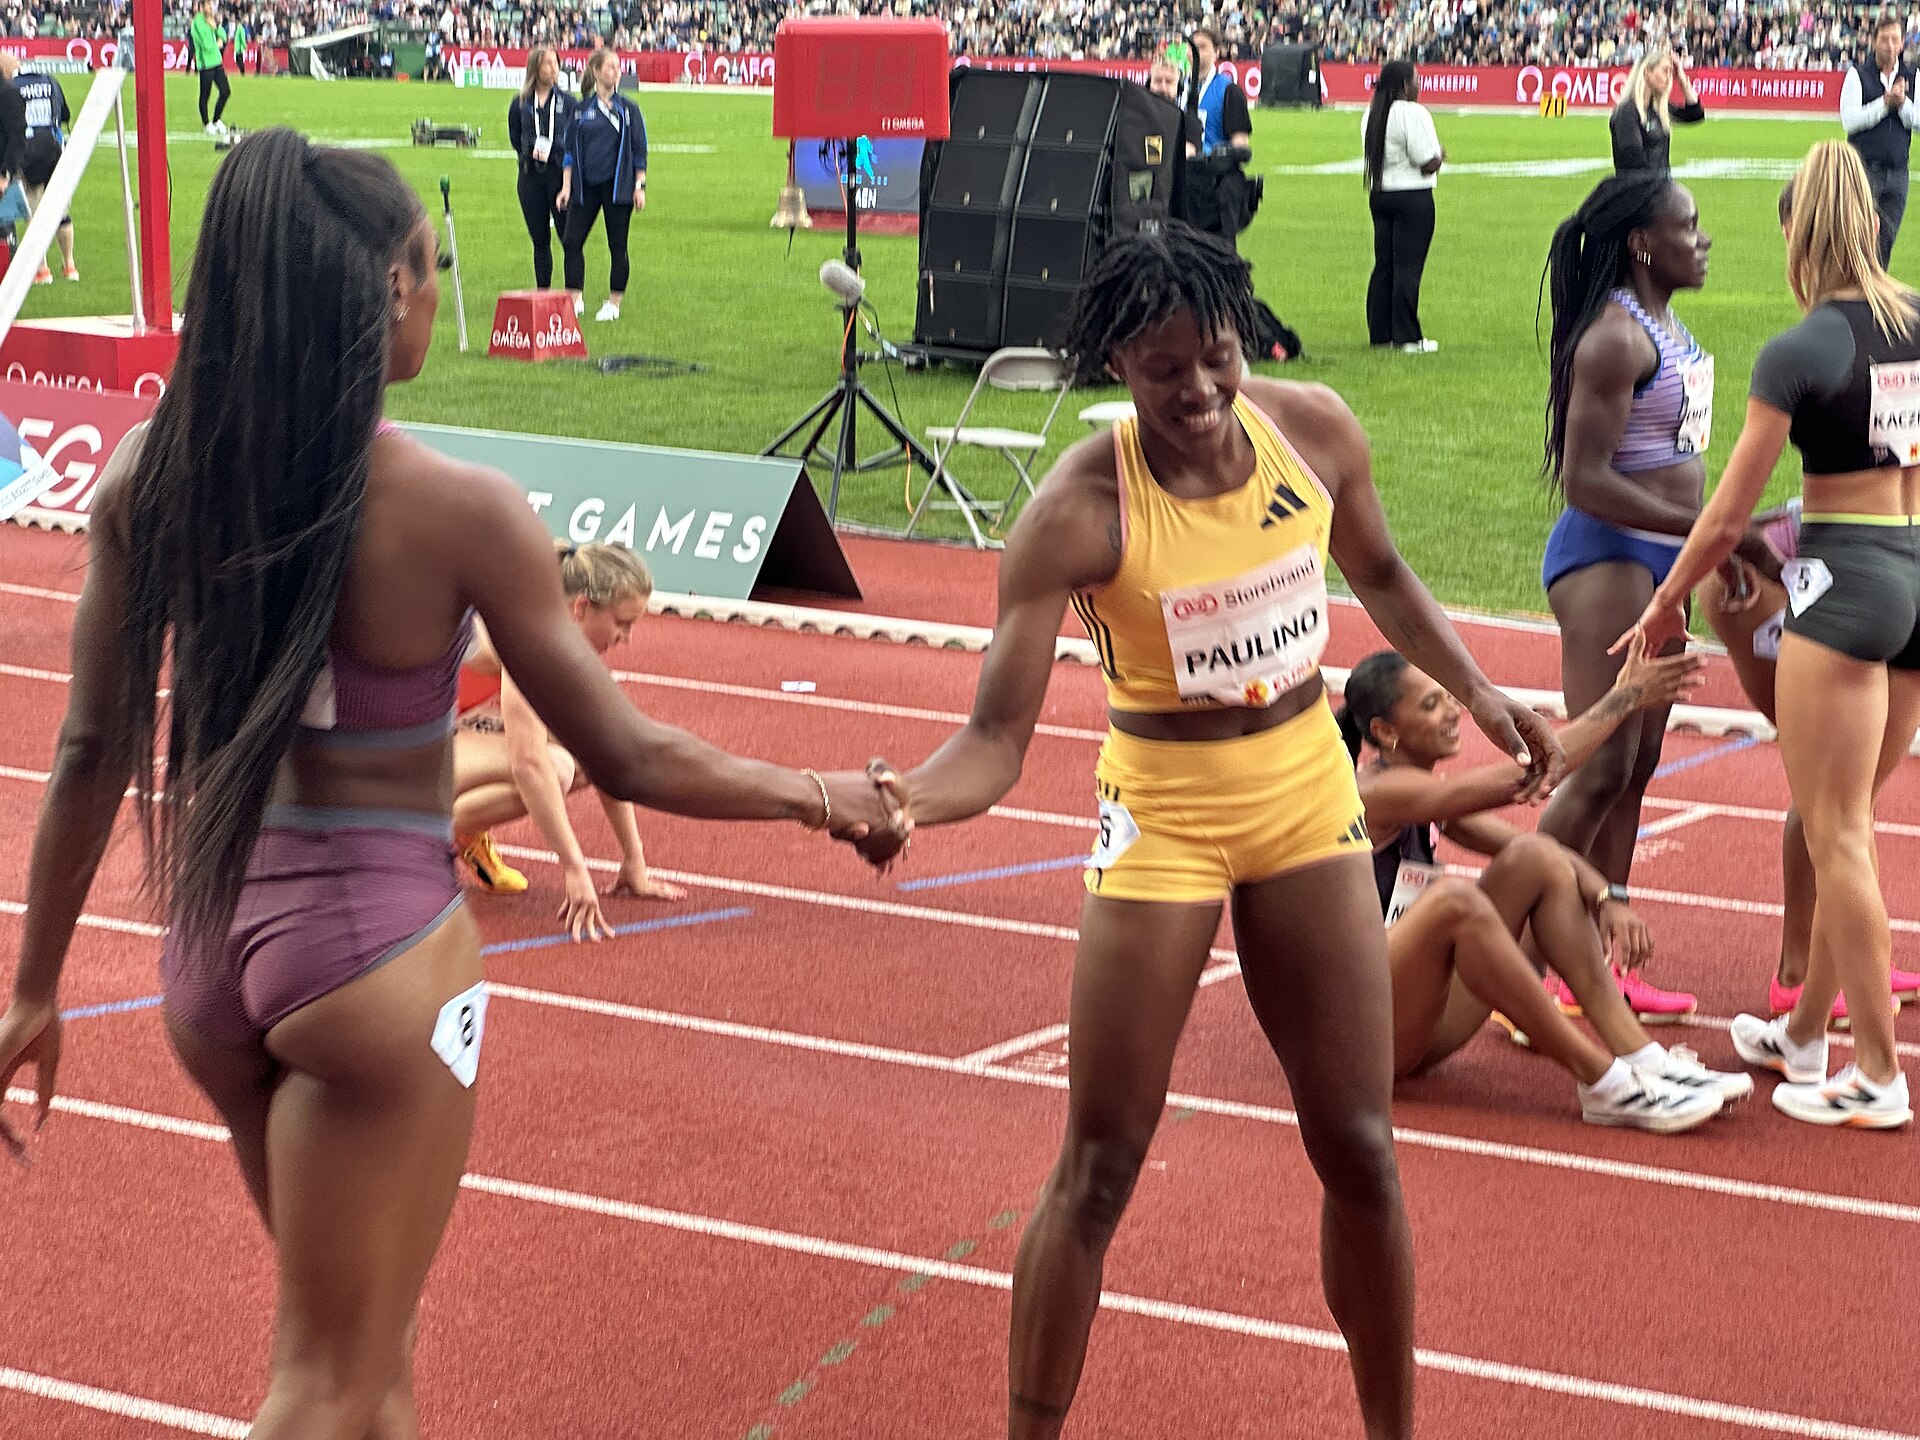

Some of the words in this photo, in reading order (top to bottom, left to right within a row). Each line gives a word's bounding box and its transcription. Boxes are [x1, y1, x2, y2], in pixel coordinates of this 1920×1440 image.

[1693, 78, 1747, 97] OFFICIAL
[1751, 79, 1824, 98] TIMEKEEPER
[892, 118, 924, 131] OMEGA
[493, 330, 530, 350] OMEGA
[536, 327, 582, 349] OMEGA
[568, 498, 767, 564] GAMES
[1223, 555, 1316, 609] Storebrand
[1185, 606, 1318, 677] PAULINO
